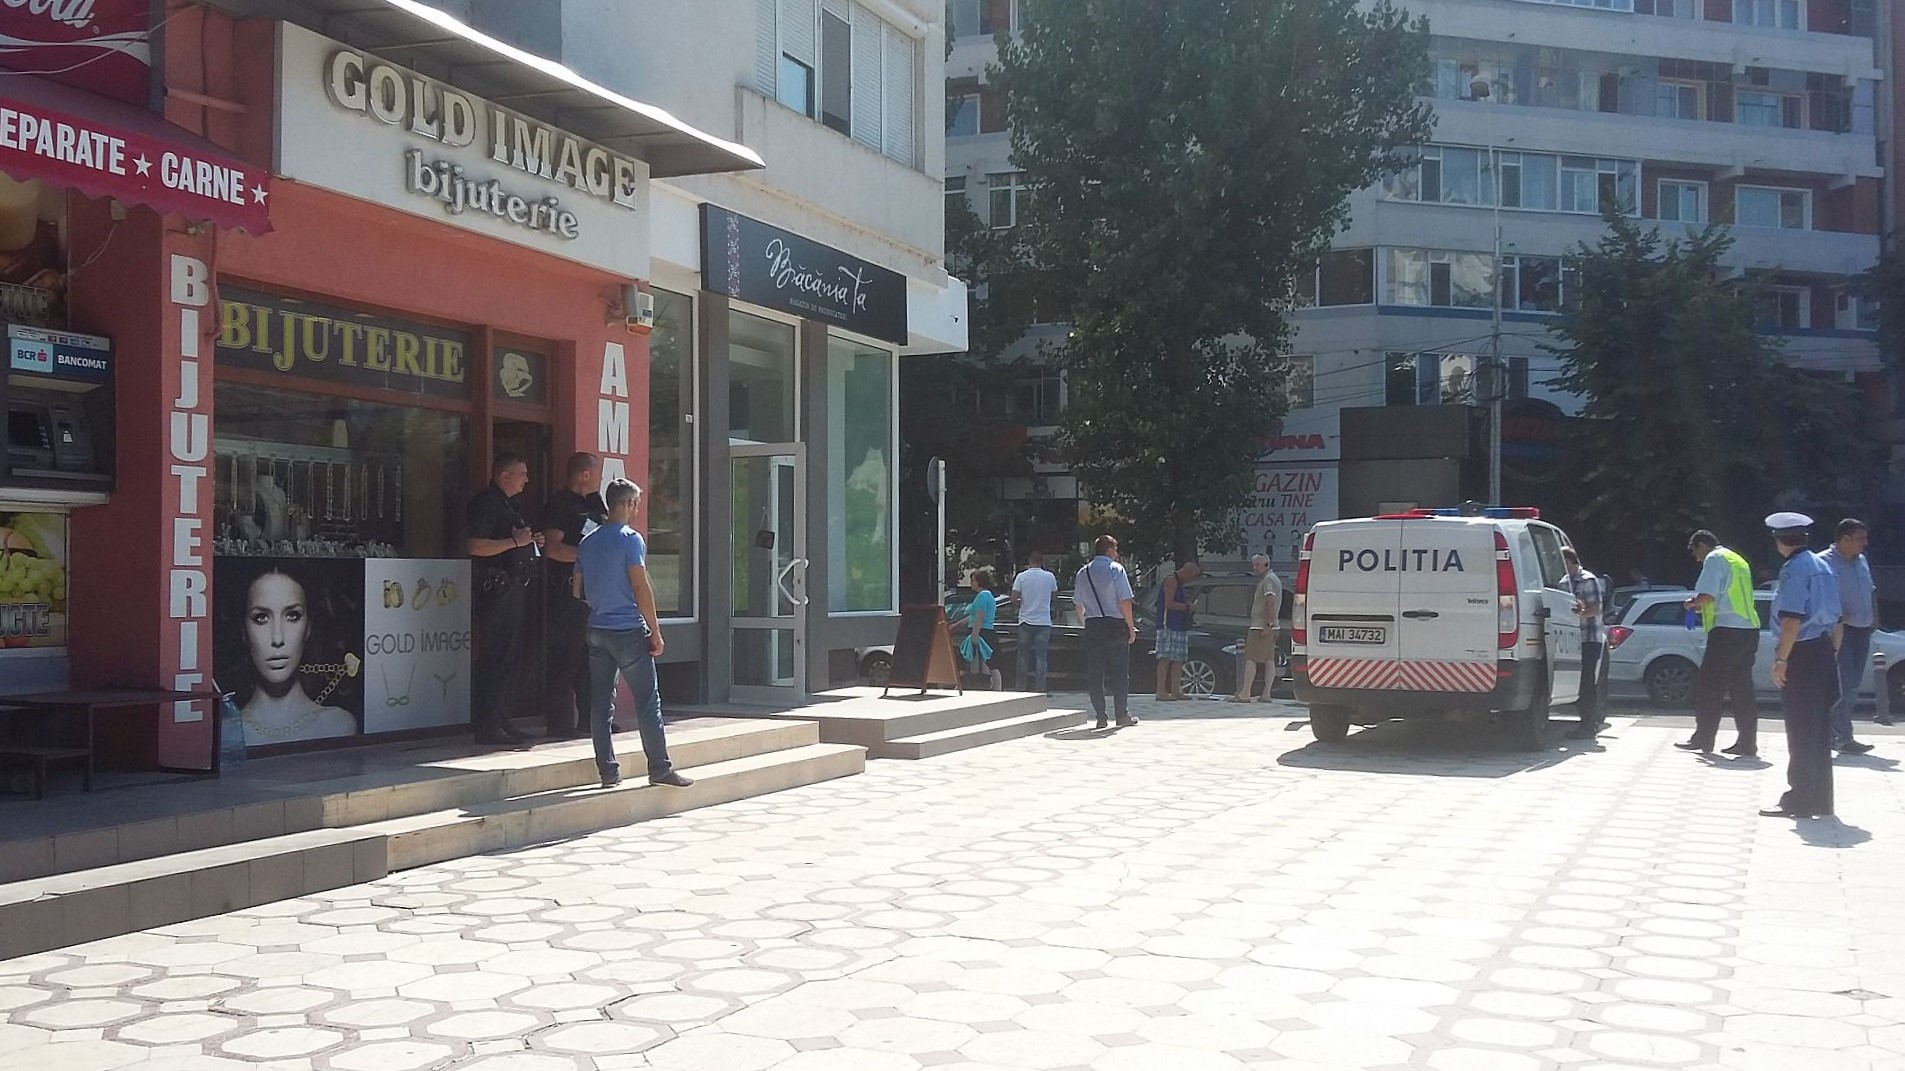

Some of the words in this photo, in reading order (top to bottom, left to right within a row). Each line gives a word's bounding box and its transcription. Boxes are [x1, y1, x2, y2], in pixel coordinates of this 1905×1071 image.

[328, 51, 476, 146] GOLD
[491, 109, 637, 210] IMAGE
[161, 151, 245, 206] CARNE
[406, 149, 579, 240] bijuterie
[217, 300, 465, 384] BIJUTERIE
[17, 349, 36, 361] BCR
[58, 355, 107, 369] BANCOMAT
[169, 254, 209, 723] BIJUTERIE
[1281, 494, 1314, 507] TINE
[1246, 513, 1285, 527] CASA
[1338, 549, 1465, 572] POLITIA
[366, 634, 415, 655] GOLD
[1328, 629, 1345, 640] MAI
[1349, 629, 1381, 641] 34732
